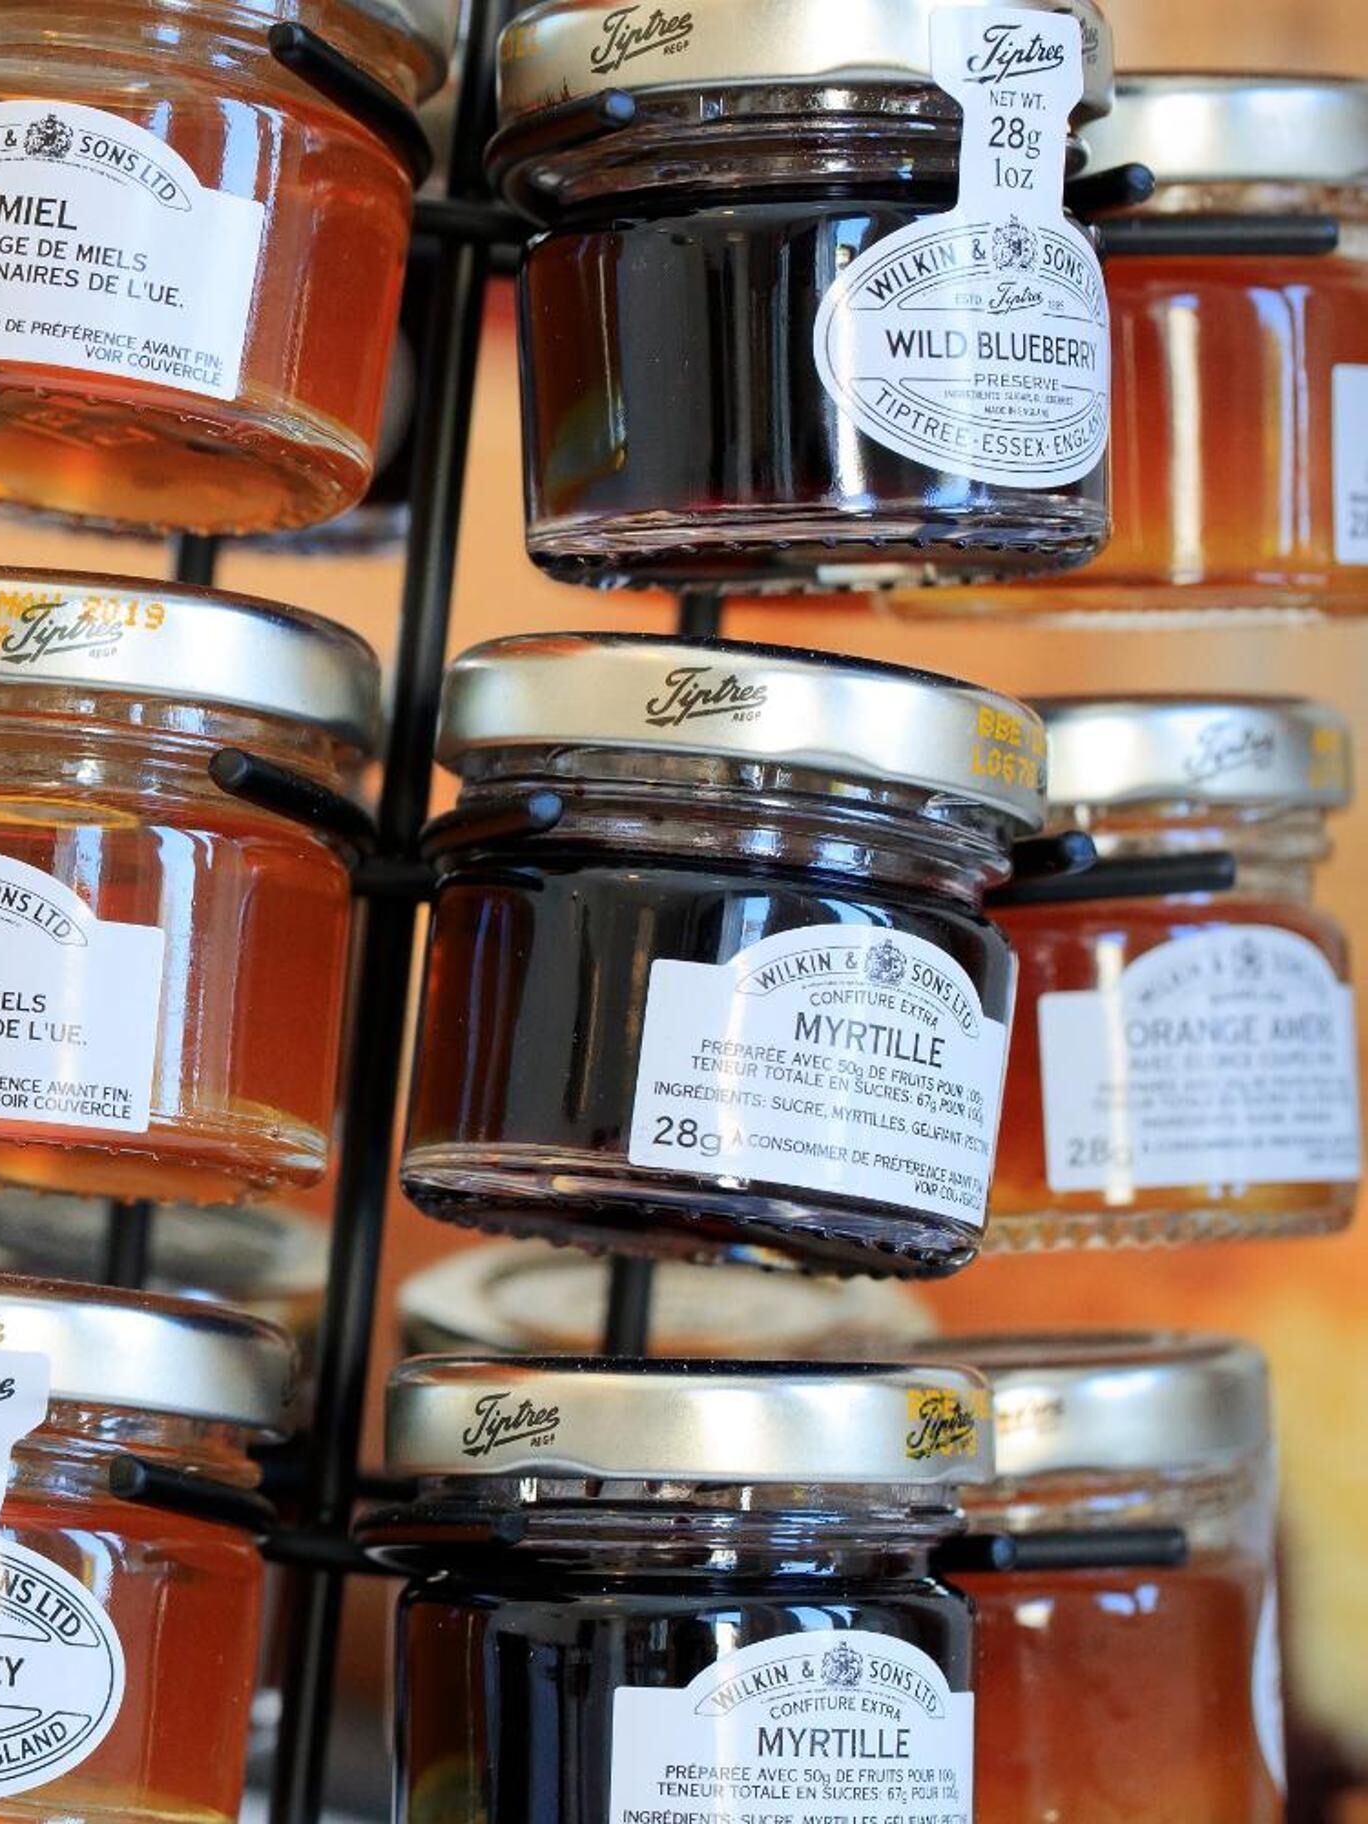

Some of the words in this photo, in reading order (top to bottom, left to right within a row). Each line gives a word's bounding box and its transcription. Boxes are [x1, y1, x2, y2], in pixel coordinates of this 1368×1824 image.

[591, 5, 693, 74] Tiptree
[963, 25, 1064, 84] Tiptree
[990, 90, 1016, 107] NET
[1022, 93, 1046, 110] WT.
[989, 116, 1042, 159] 28g
[5, 129, 18, 147] &
[80, 135, 139, 171] SONS
[139, 166, 177, 203] LTD
[995, 158, 1034, 190] 1oz
[36, 239, 70, 261] DE
[76, 244, 148, 272] MIELS
[865, 244, 957, 302] WILKIN
[971, 238, 987, 261] &
[1042, 245, 1084, 285] SONS
[88, 272, 119, 295] DE
[127, 280, 185, 309] L'UE.
[5, 318, 27, 334] DE
[31, 320, 137, 349] PRÉFÉRENCE
[142, 340, 192, 361] AVANT
[886, 329, 968, 359] WILD
[977, 330, 1098, 372] BLUEBERRY
[84, 344, 123, 364] VOIR
[127, 353, 222, 387] COUVERCLE
[973, 373, 1060, 391] PRESERVE
[874, 388, 969, 448] TIPTREE
[982, 433, 1046, 457] ESSEX
[0, 601, 124, 664] Tiptree
[645, 666, 768, 728] Tiptree
[33, 902, 72, 940] LTD
[755, 953, 832, 991] WILKIN
[845, 951, 859, 970] &
[911, 964, 953, 1001] SONS
[809, 988, 896, 1012] CONFITURE
[900, 998, 939, 1031] EXTRA
[28, 1022, 88, 1047] L'UE.
[794, 1011, 946, 1070] MYRTILLE
[692, 1055, 758, 1079] TENEUR
[764, 1065, 825, 1088] TOTALE
[829, 1076, 850, 1091] EN
[700, 1039, 787, 1064] PRÉPARÉE
[791, 1052, 833, 1070] AVEC
[838, 1060, 864, 1080] 50g
[868, 1065, 888, 1080] DE
[891, 1068, 934, 1092] FRUITS
[33, 1096, 132, 1119] COUVERCLE
[46, 1081, 99, 1099] AVANT
[770, 1096, 828, 1118] SUCRE,
[652, 1115, 723, 1157] 28g
[747, 1134, 848, 1162] CONSOMMER
[851, 1150, 871, 1166] DE
[873, 1153, 947, 1183] PRÉFÉRENCE
[462, 1391, 560, 1457] Tiptree
[36, 1596, 83, 1639] LTD
[711, 1663, 789, 1710] WILKIN
[801, 1660, 814, 1679] &
[869, 1661, 914, 1691] SONS
[914, 1681, 938, 1713] LTD
[769, 1696, 857, 1722] CONFITURE
[861, 1698, 902, 1722] EXTRA
[757, 1727, 911, 1759] MYRTILLE
[656, 1781, 724, 1798] TENEUR
[730, 1785, 793, 1800] TOTALE
[795, 1786, 817, 1800] EN
[664, 1762, 751, 1782] PRÉPARÉE
[756, 1768, 799, 1783] AVEC
[835, 1768, 855, 1783] DE
[858, 1768, 904, 1783] FRUITS
[908, 1769, 935, 1783] POUR
